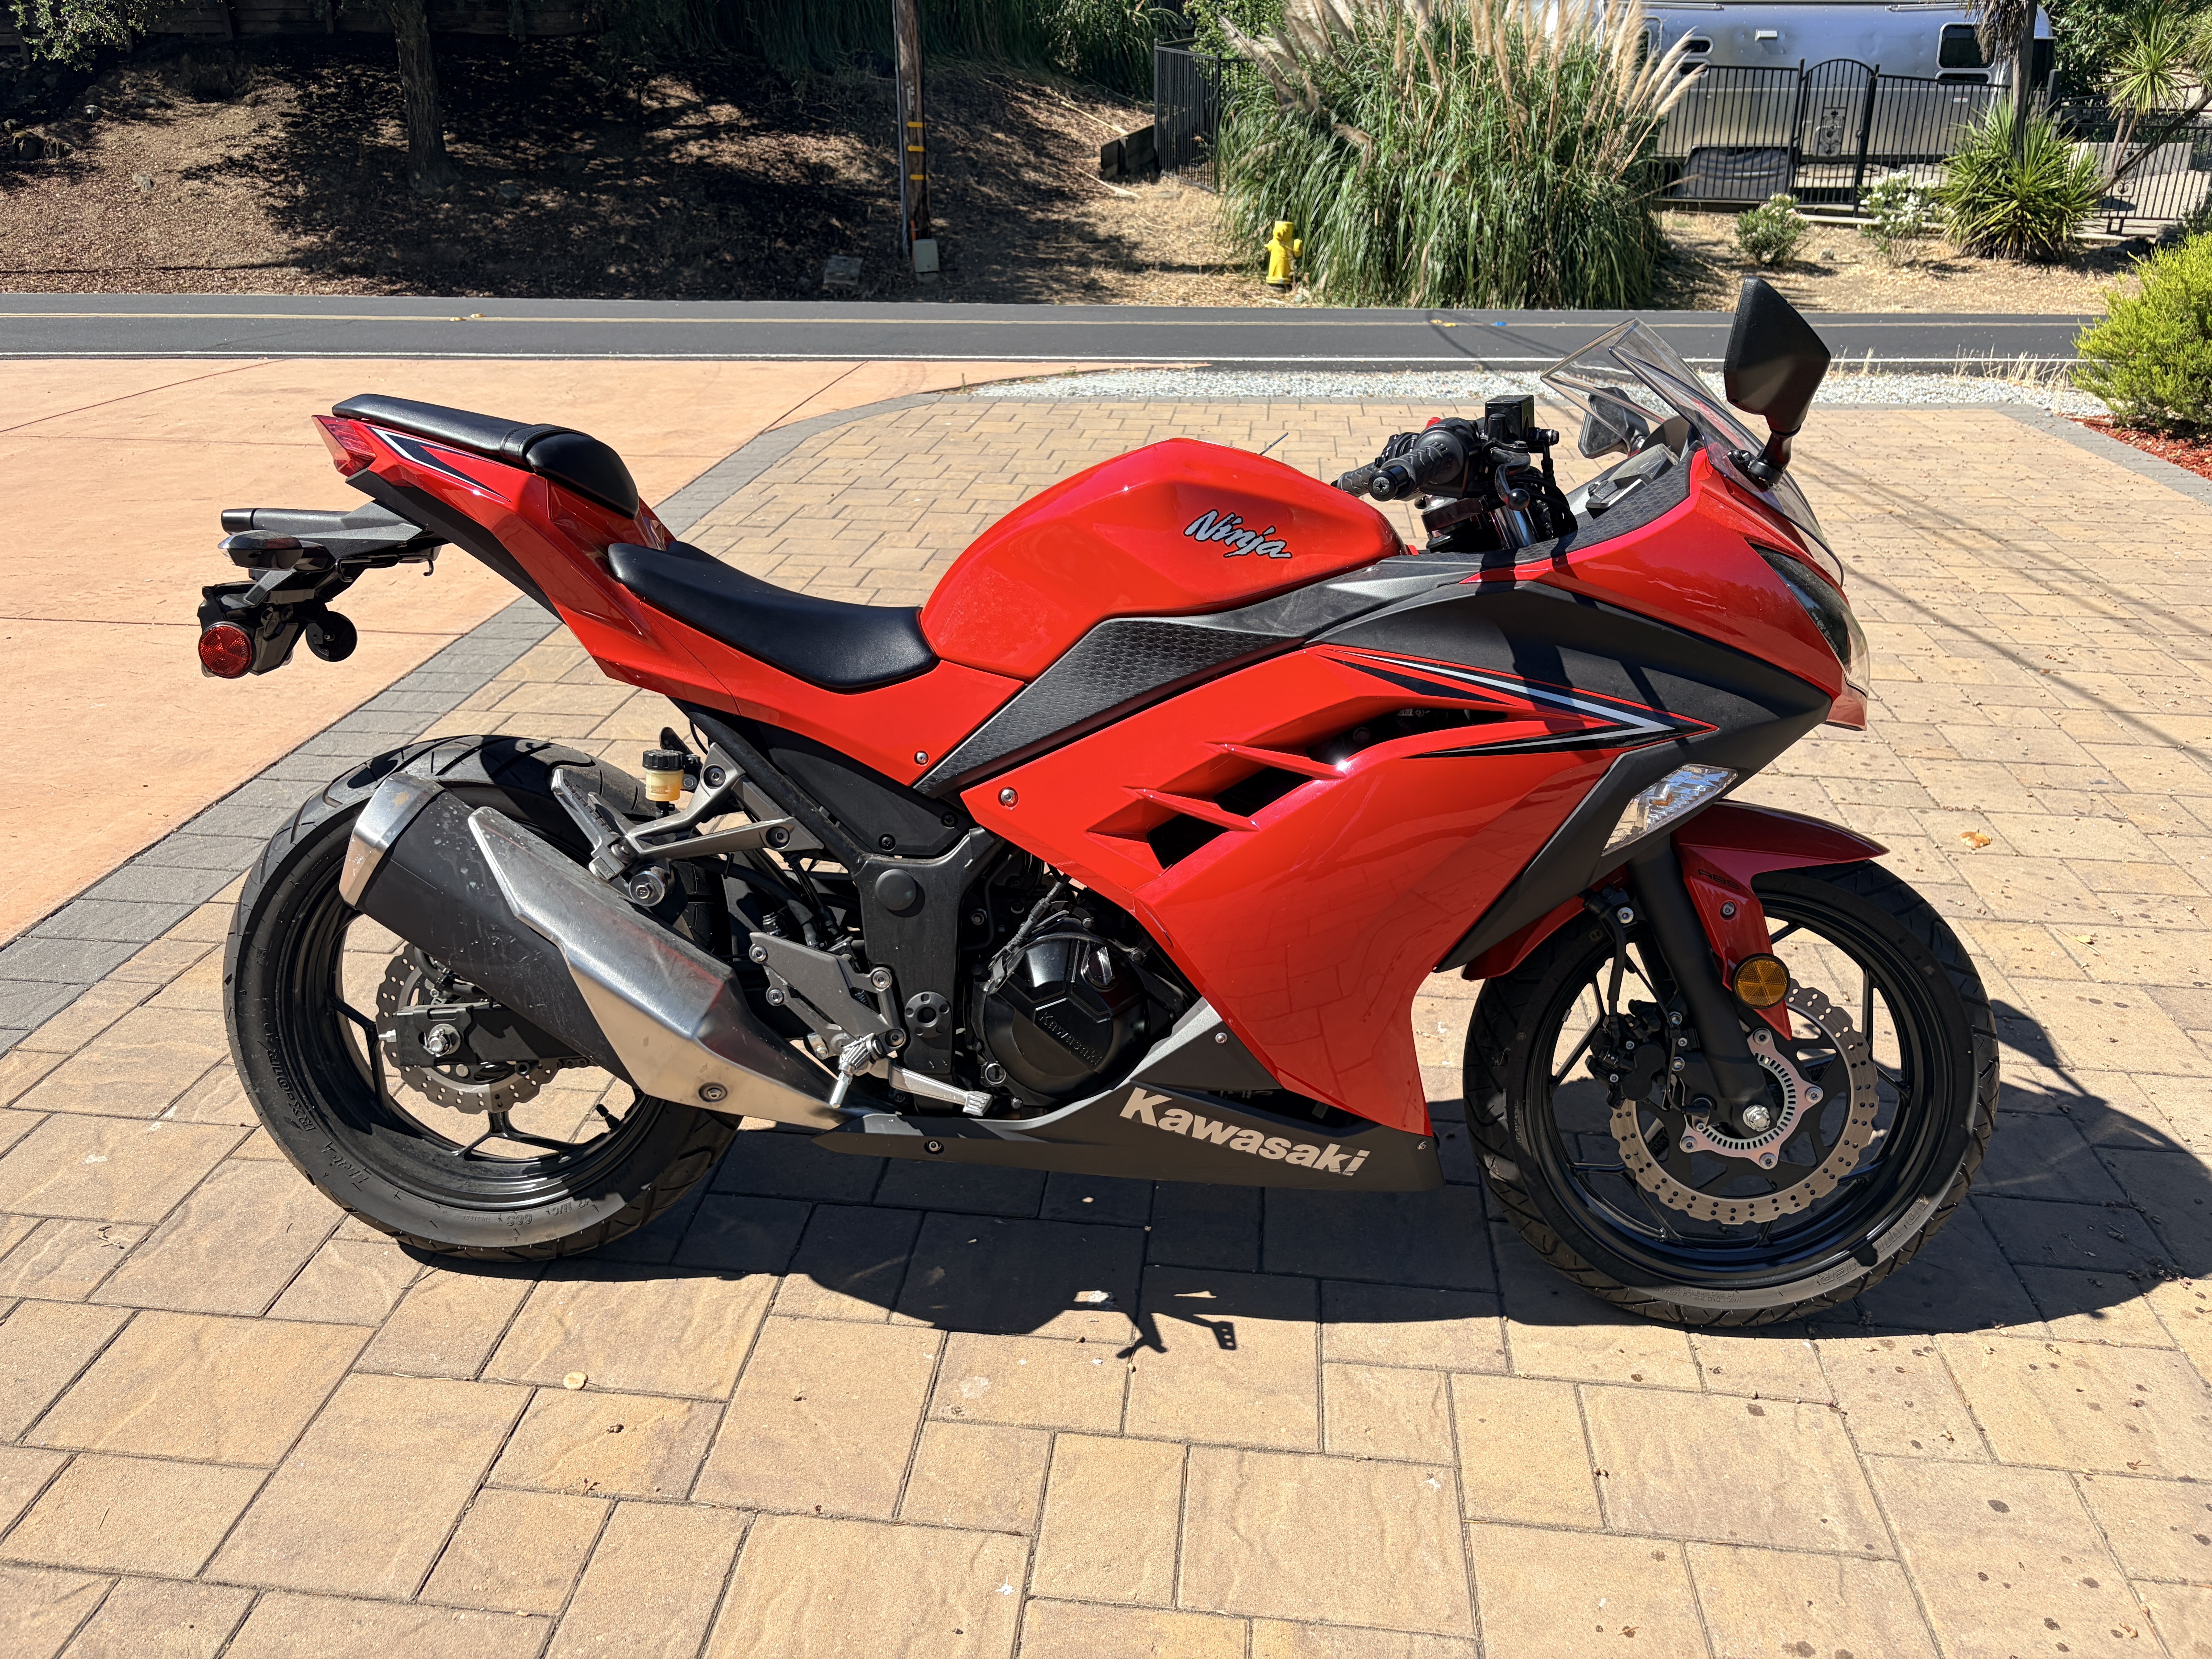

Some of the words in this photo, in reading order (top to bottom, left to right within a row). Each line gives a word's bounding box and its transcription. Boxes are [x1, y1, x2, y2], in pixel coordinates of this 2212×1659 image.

[1183, 508, 1293, 559] Ninja
[1698, 869, 1740, 890] ABS
[1038, 1011, 1103, 1066] Kawasaki
[267, 1049, 316, 1131] RX-01R
[1119, 1086, 1370, 1177] Kawasaki
[462, 1214, 491, 1222] TUBELESS
[507, 1213, 532, 1226] 66S
